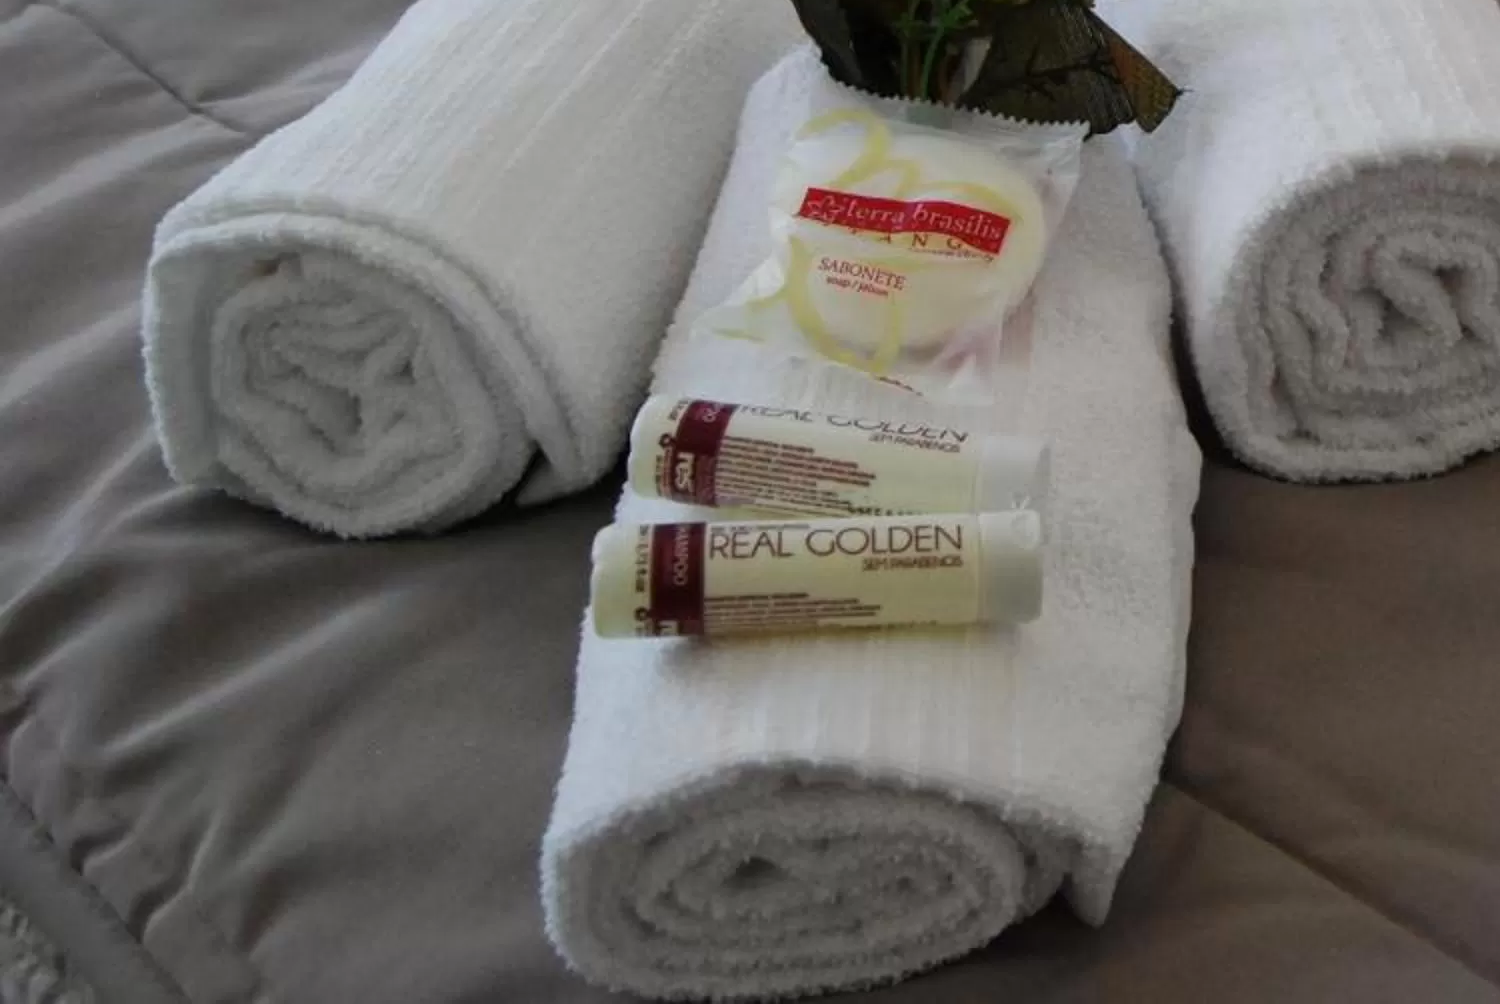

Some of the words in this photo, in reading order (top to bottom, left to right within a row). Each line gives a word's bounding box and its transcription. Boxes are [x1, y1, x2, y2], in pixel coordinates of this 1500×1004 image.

[847, 198, 905, 223] terra
[913, 202, 1002, 239] brasilis
[818, 257, 906, 291] SABONETE
[709, 529, 795, 559] REAL
[805, 524, 963, 557] GOLDEN
